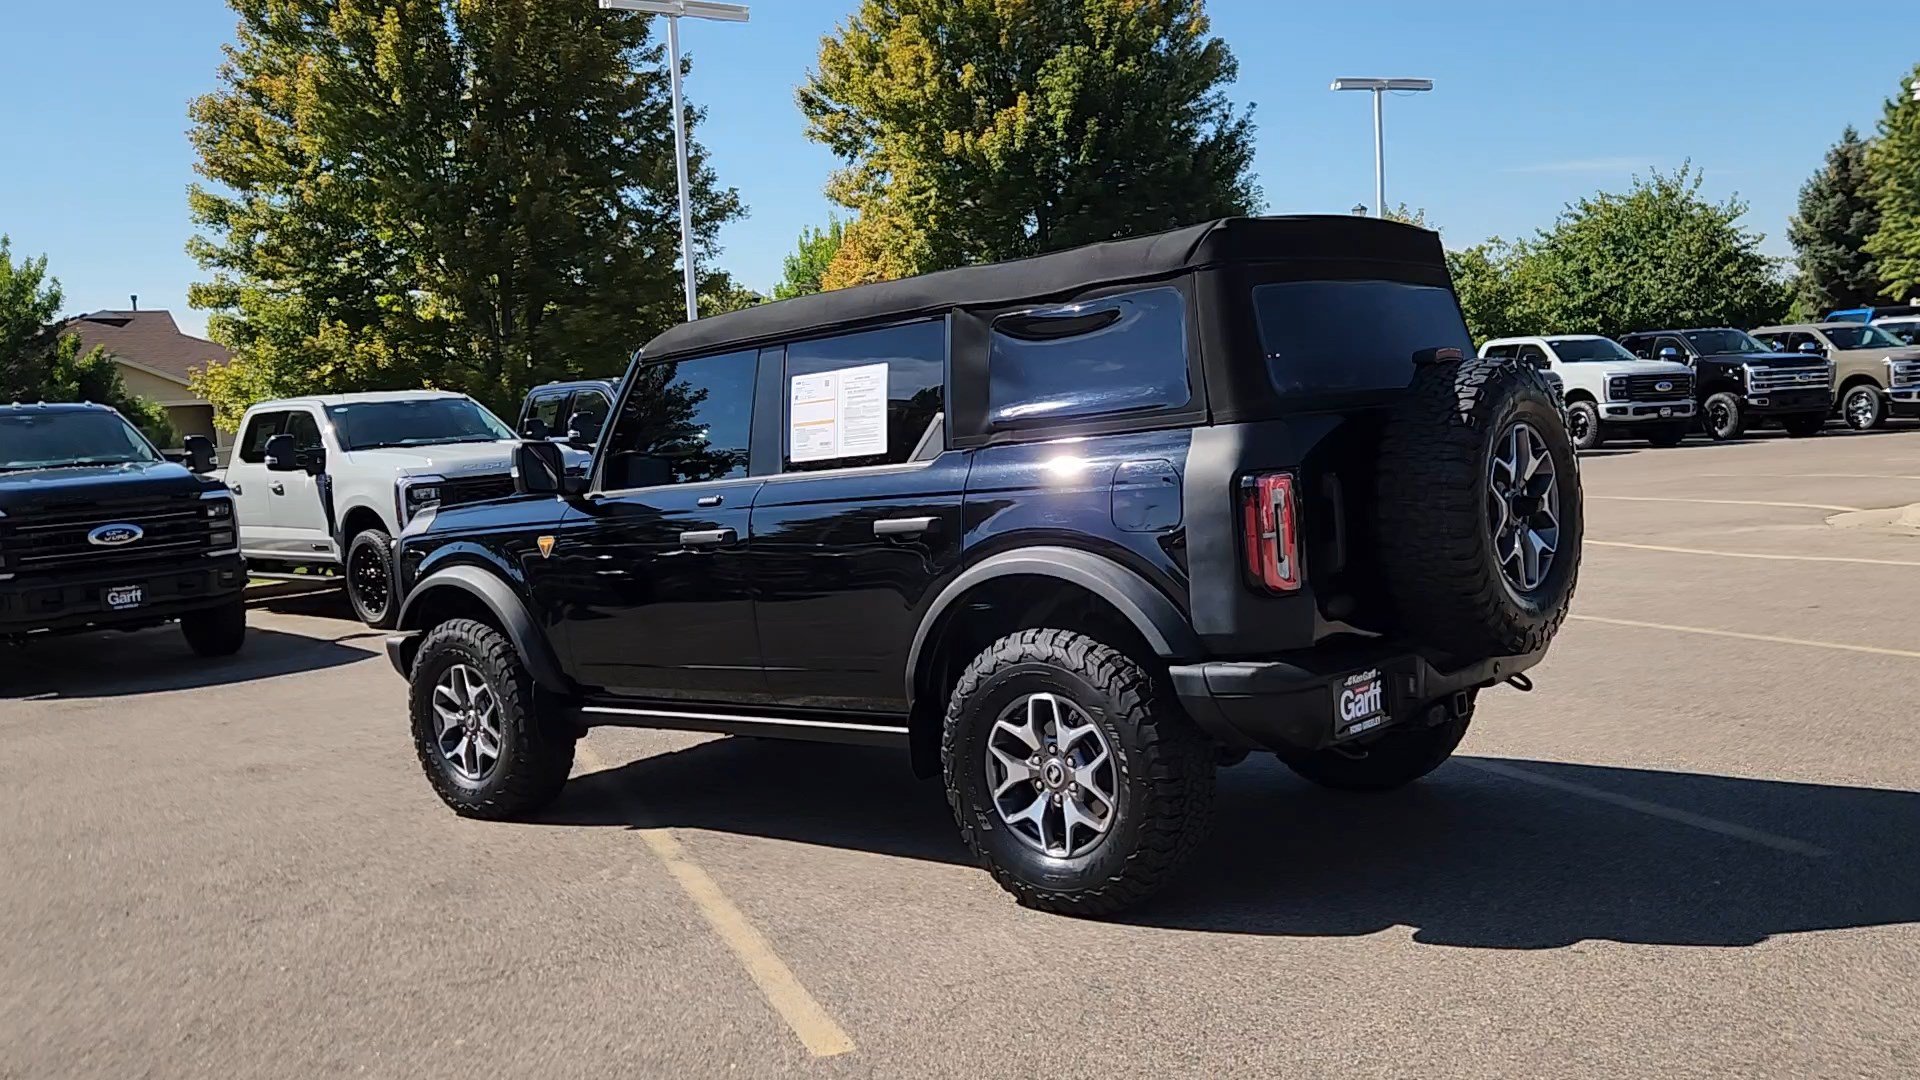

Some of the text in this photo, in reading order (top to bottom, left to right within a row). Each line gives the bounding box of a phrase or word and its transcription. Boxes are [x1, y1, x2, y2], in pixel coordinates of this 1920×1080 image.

[104, 530, 130, 541] Ford
[107, 589, 142, 605] Garff
[1340, 680, 1382, 721] Garff
